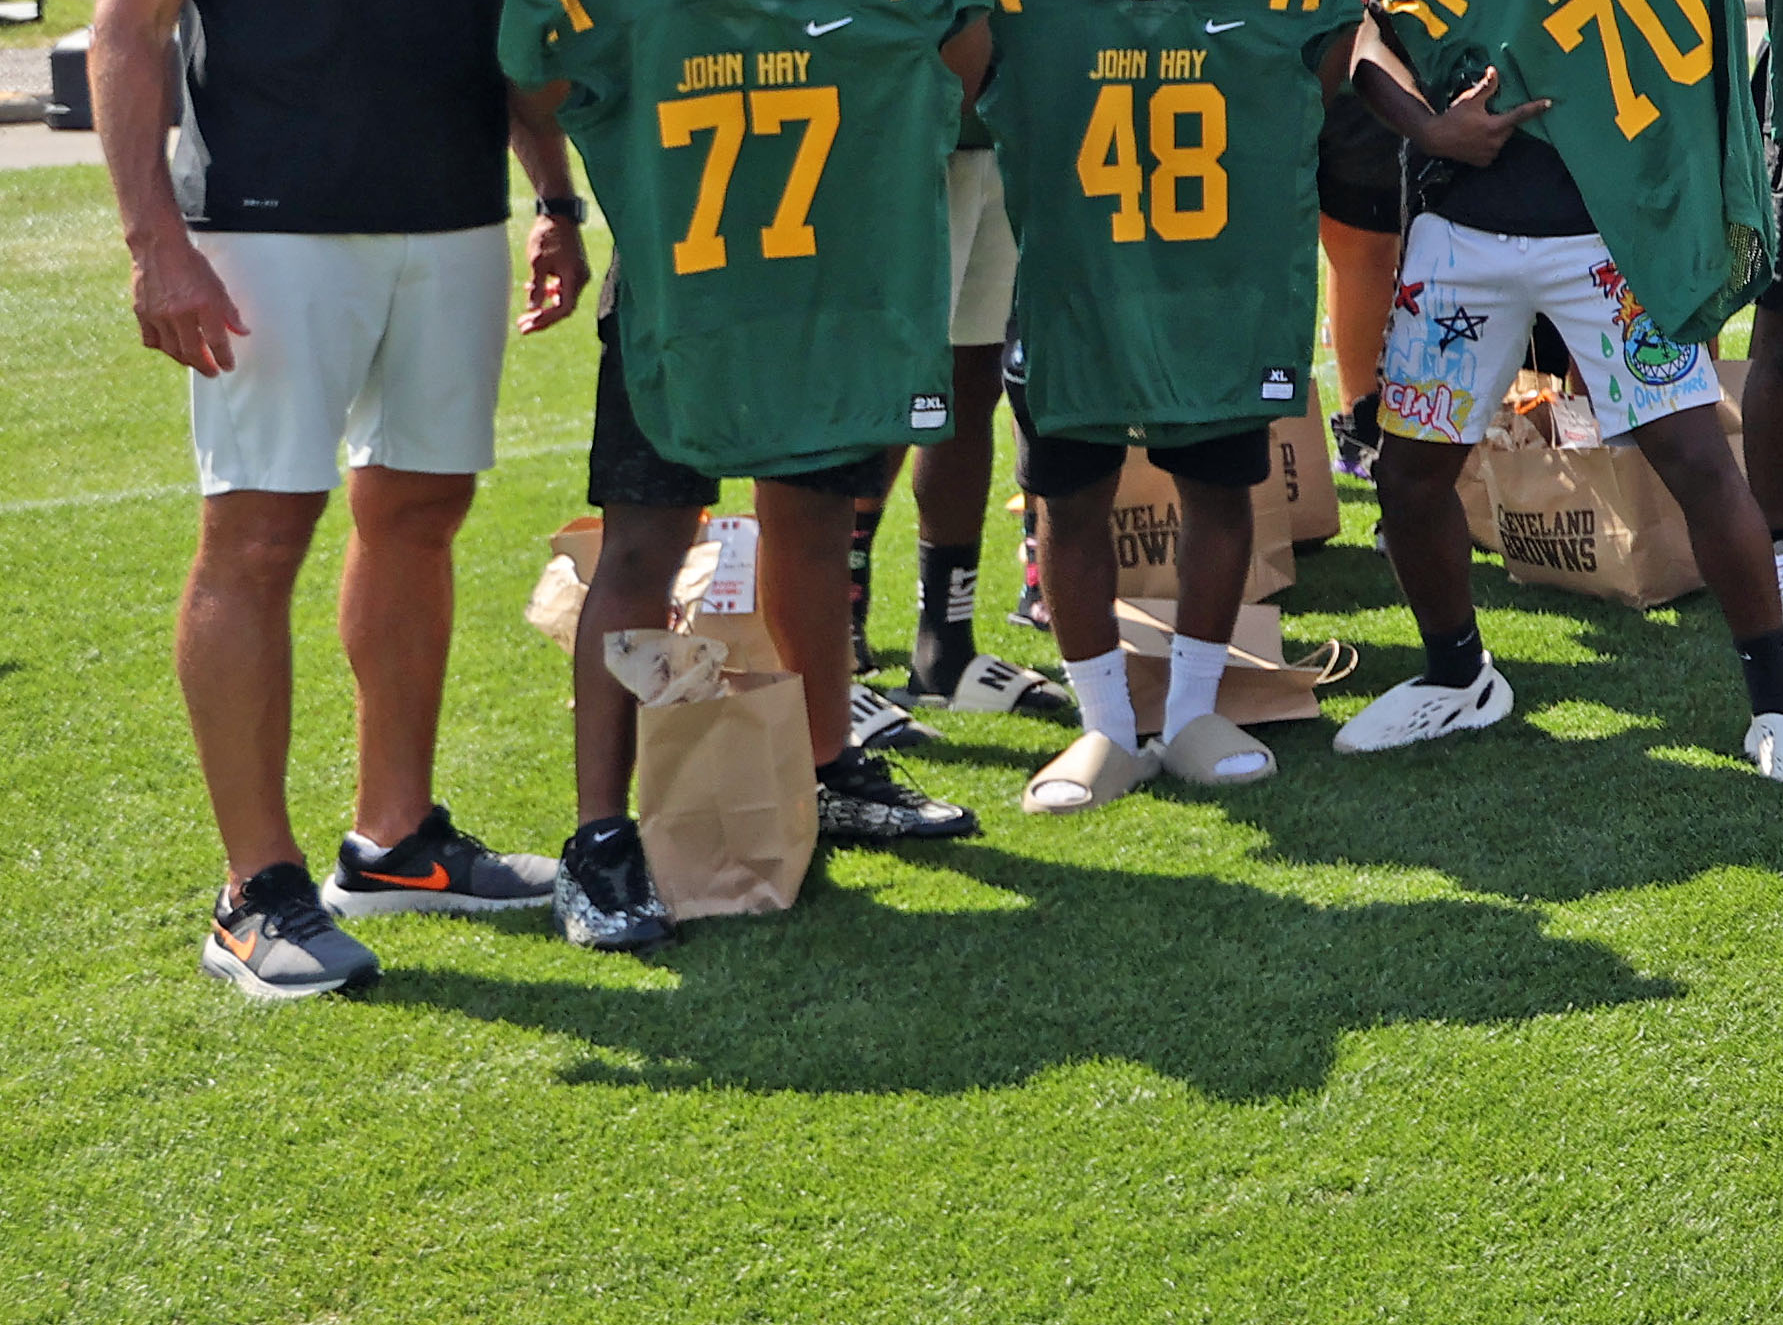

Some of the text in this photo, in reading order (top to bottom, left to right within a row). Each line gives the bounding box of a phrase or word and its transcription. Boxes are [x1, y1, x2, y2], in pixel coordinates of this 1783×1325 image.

[677, 51, 811, 92] JOHN HAY
[1089, 49, 1208, 80] JOHN HAY
[657, 86, 841, 276] 77
[1077, 83, 1229, 244] 48
[1269, 367, 1289, 382] XL
[913, 395, 946, 411] 2XL
